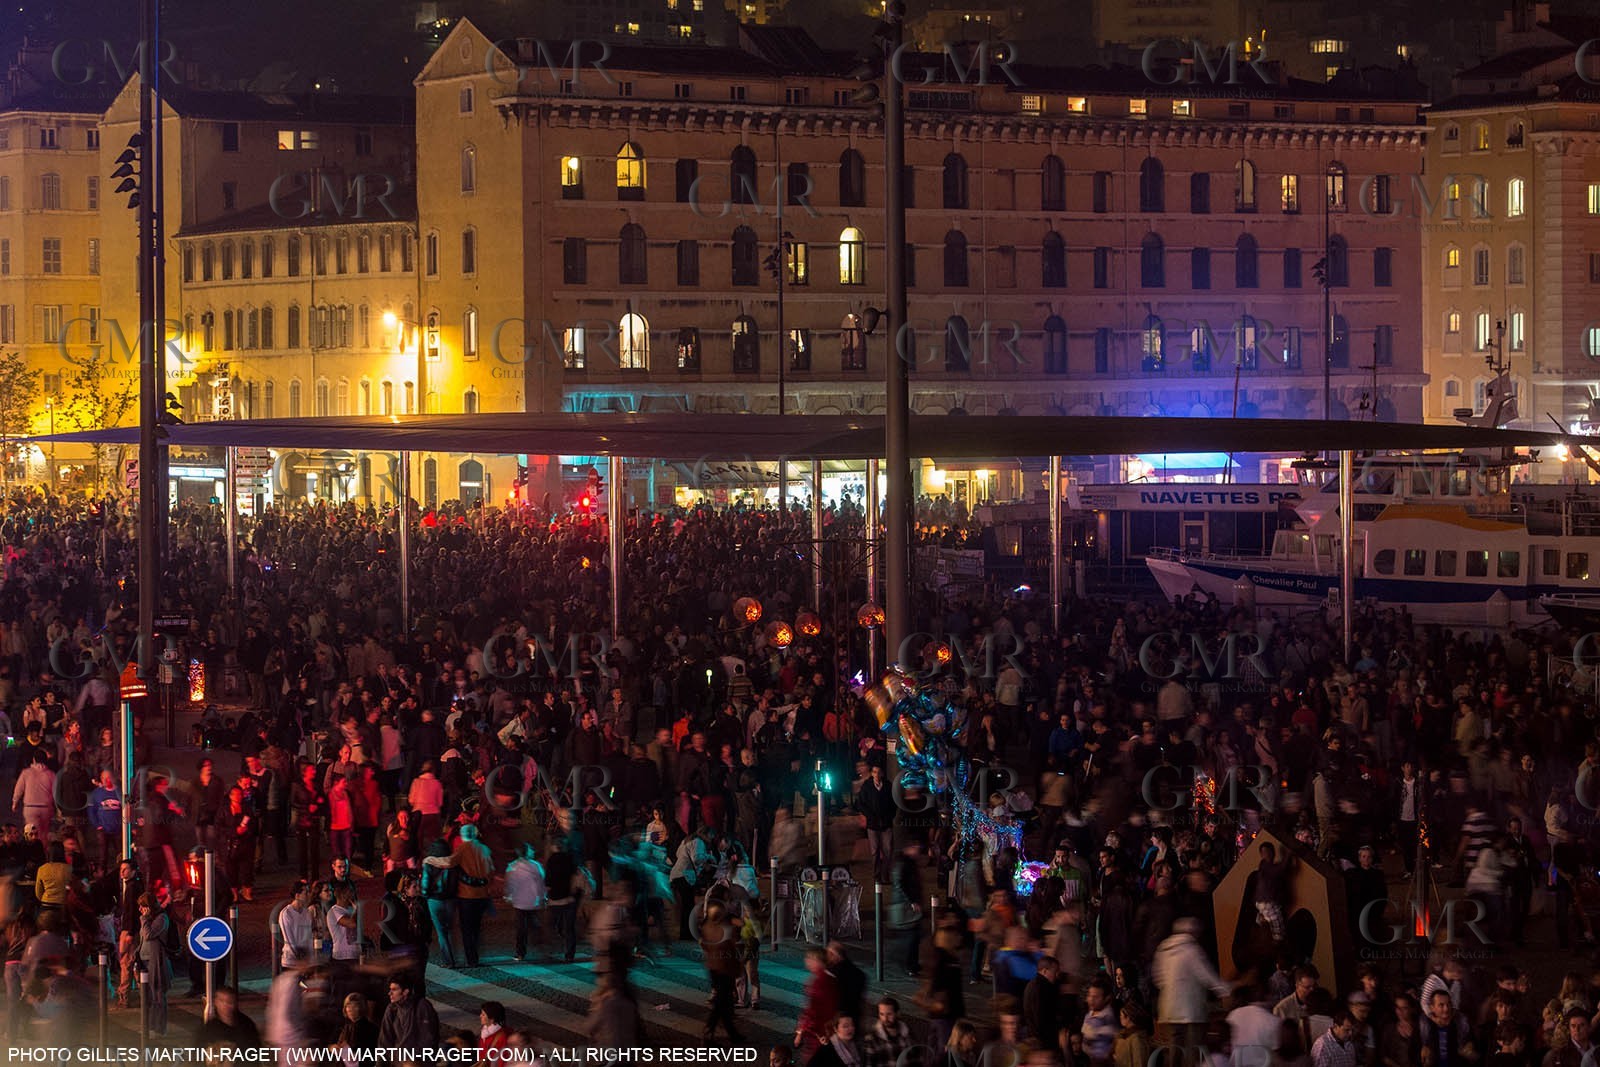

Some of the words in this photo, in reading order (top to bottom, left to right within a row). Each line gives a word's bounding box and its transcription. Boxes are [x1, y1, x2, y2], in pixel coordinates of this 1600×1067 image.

[1140, 491, 1259, 504] NAVETTES
[1252, 575, 1295, 588] Chevalier
[1296, 580, 1318, 590] Paul
